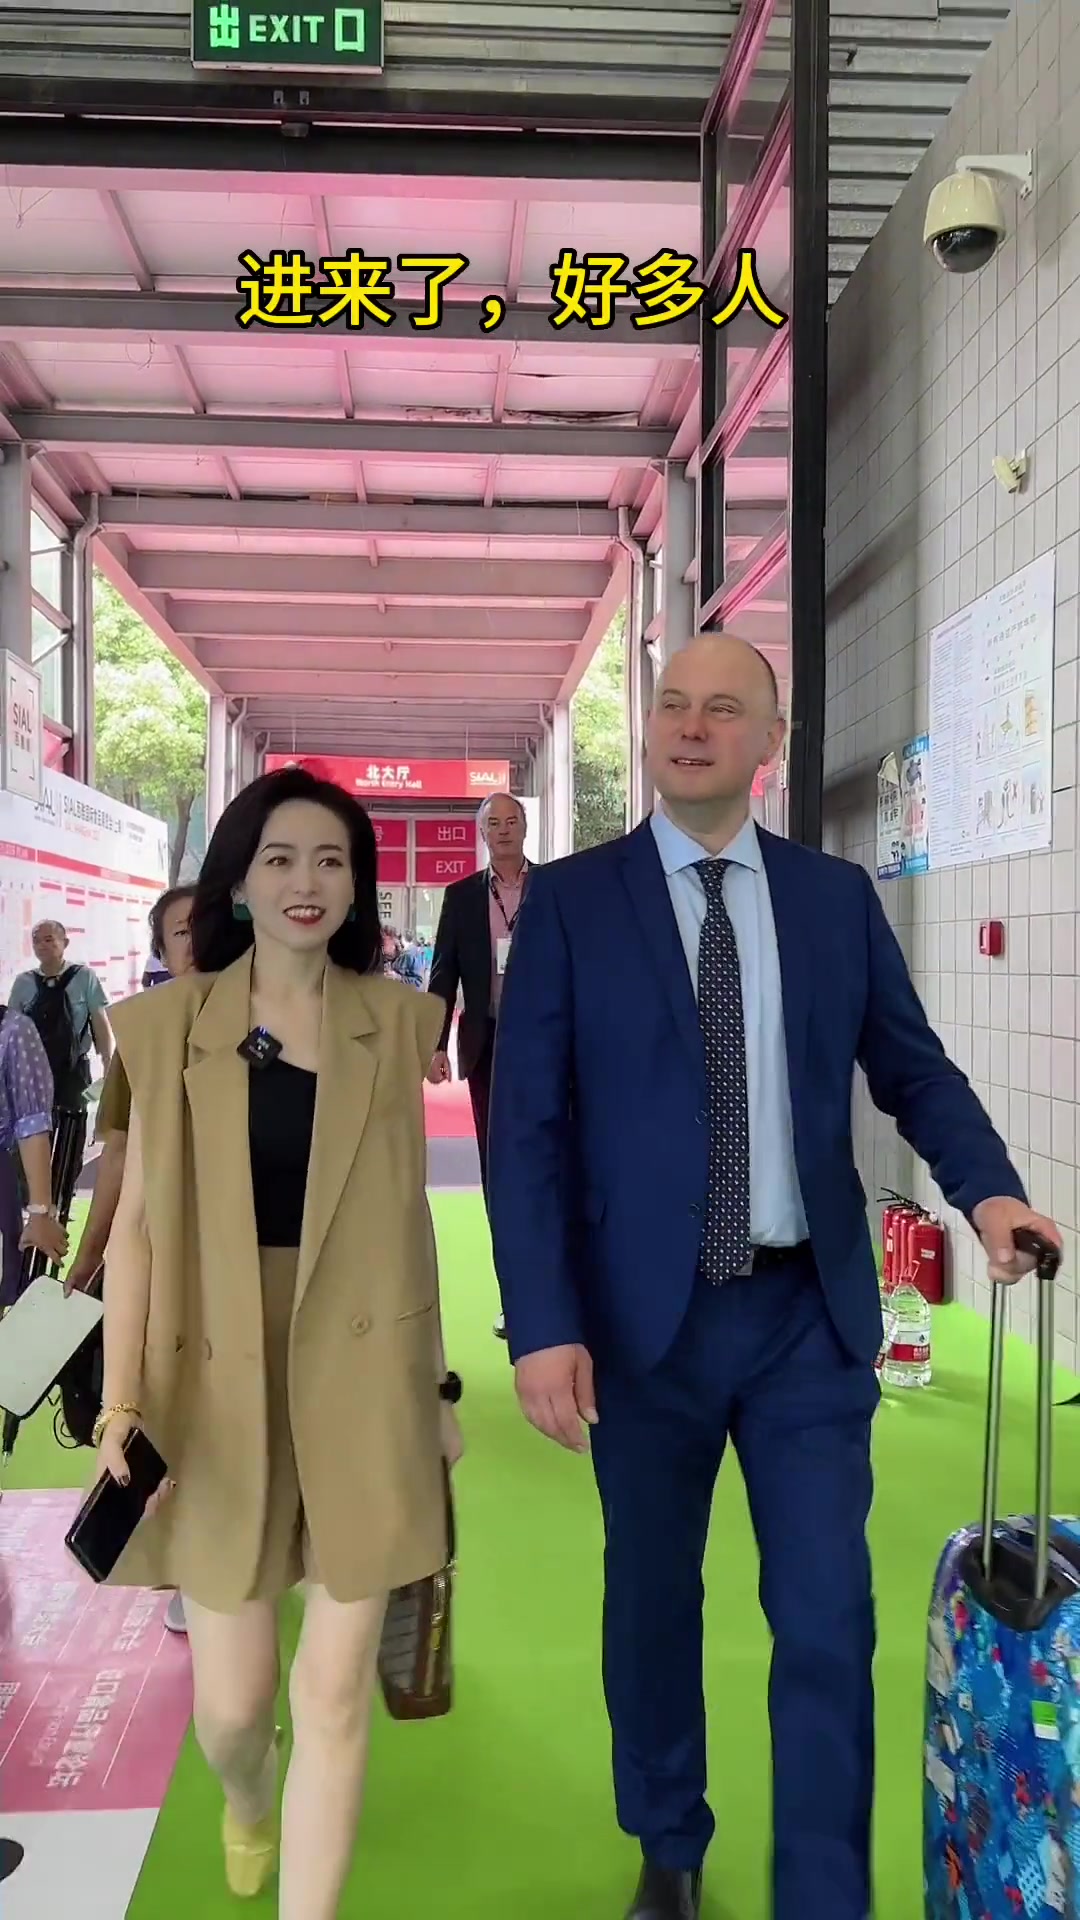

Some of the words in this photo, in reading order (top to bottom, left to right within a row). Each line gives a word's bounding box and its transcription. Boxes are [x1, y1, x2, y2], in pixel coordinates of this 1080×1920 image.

[209, 4, 240, 48] 出
[249, 14, 325, 43] EXIT
[334, 8, 365, 52] 口
[13, 702, 32, 734] SIAL
[365, 763, 410, 780] 北大厅
[437, 826, 466, 841] 出口
[435, 860, 466, 874] EXIT
